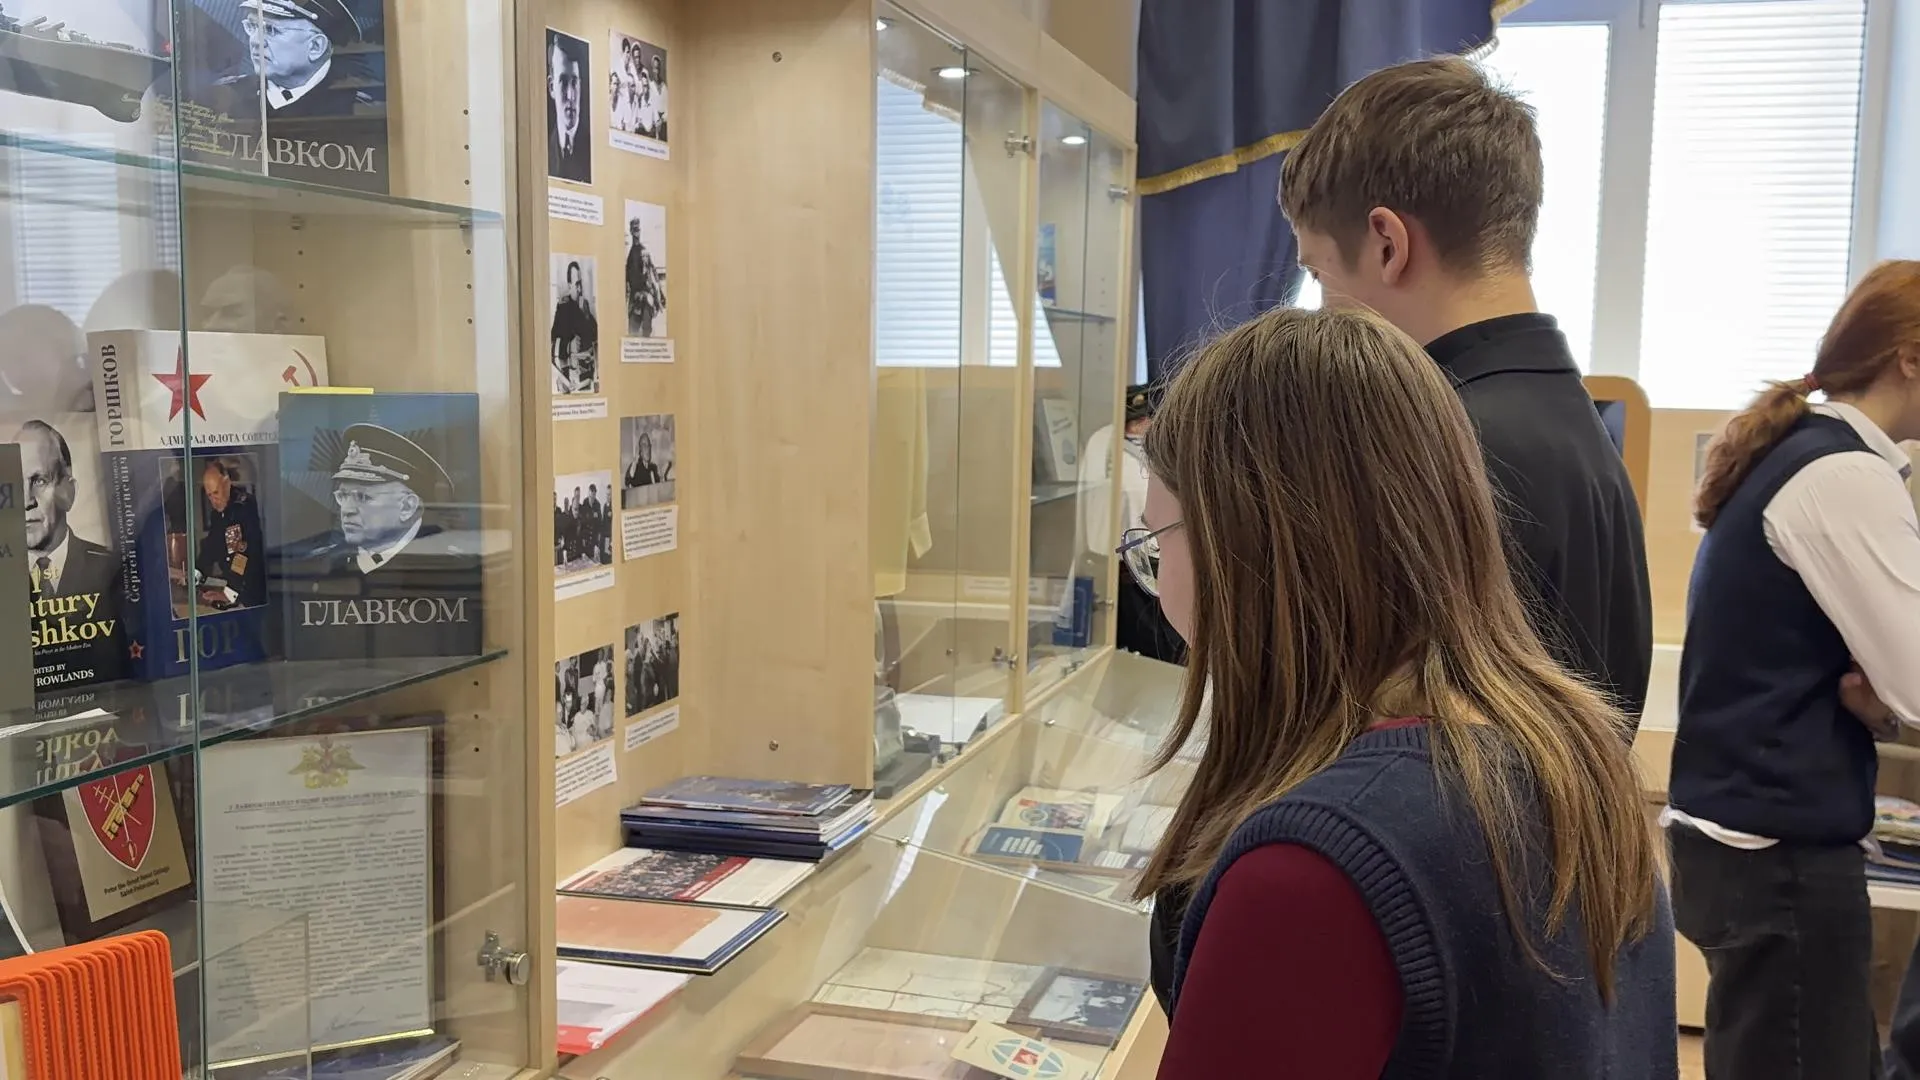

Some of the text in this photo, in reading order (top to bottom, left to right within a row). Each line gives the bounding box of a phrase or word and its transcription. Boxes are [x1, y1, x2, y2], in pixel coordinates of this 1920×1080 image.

[212, 131, 377, 173] ГЛАВКОМ
[101, 344, 125, 446] ГОРШКОВ
[208, 433, 240, 443] ФЛОТА
[120, 456, 141, 602] Сергей Георгиевич
[300, 597, 469, 627] ГЛАВКОМ
[32, 617, 115, 648] shkov
[33, 663, 66, 675] DITED BY
[36, 669, 95, 687] ROWLANDS
